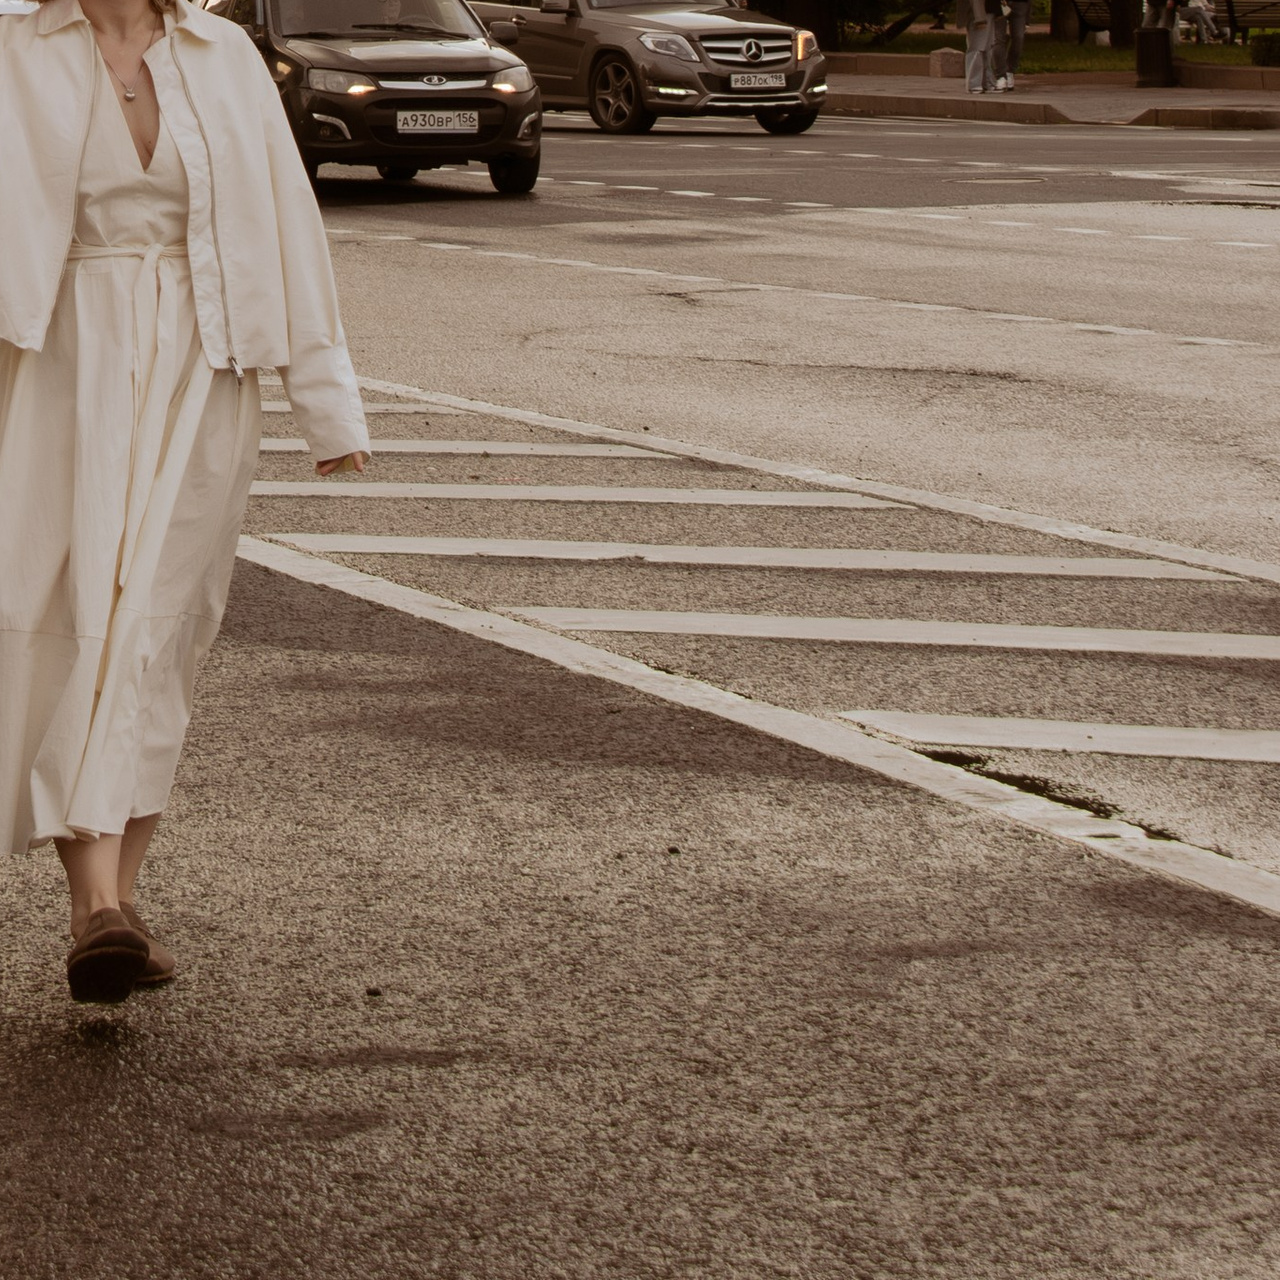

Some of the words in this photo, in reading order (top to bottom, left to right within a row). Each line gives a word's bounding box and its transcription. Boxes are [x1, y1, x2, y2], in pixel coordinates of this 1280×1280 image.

[734, 75, 768, 86] Р887ОК
[770, 74, 782, 82] 198
[402, 113, 453, 127] А930ВР
[455, 113, 476, 123] 156
